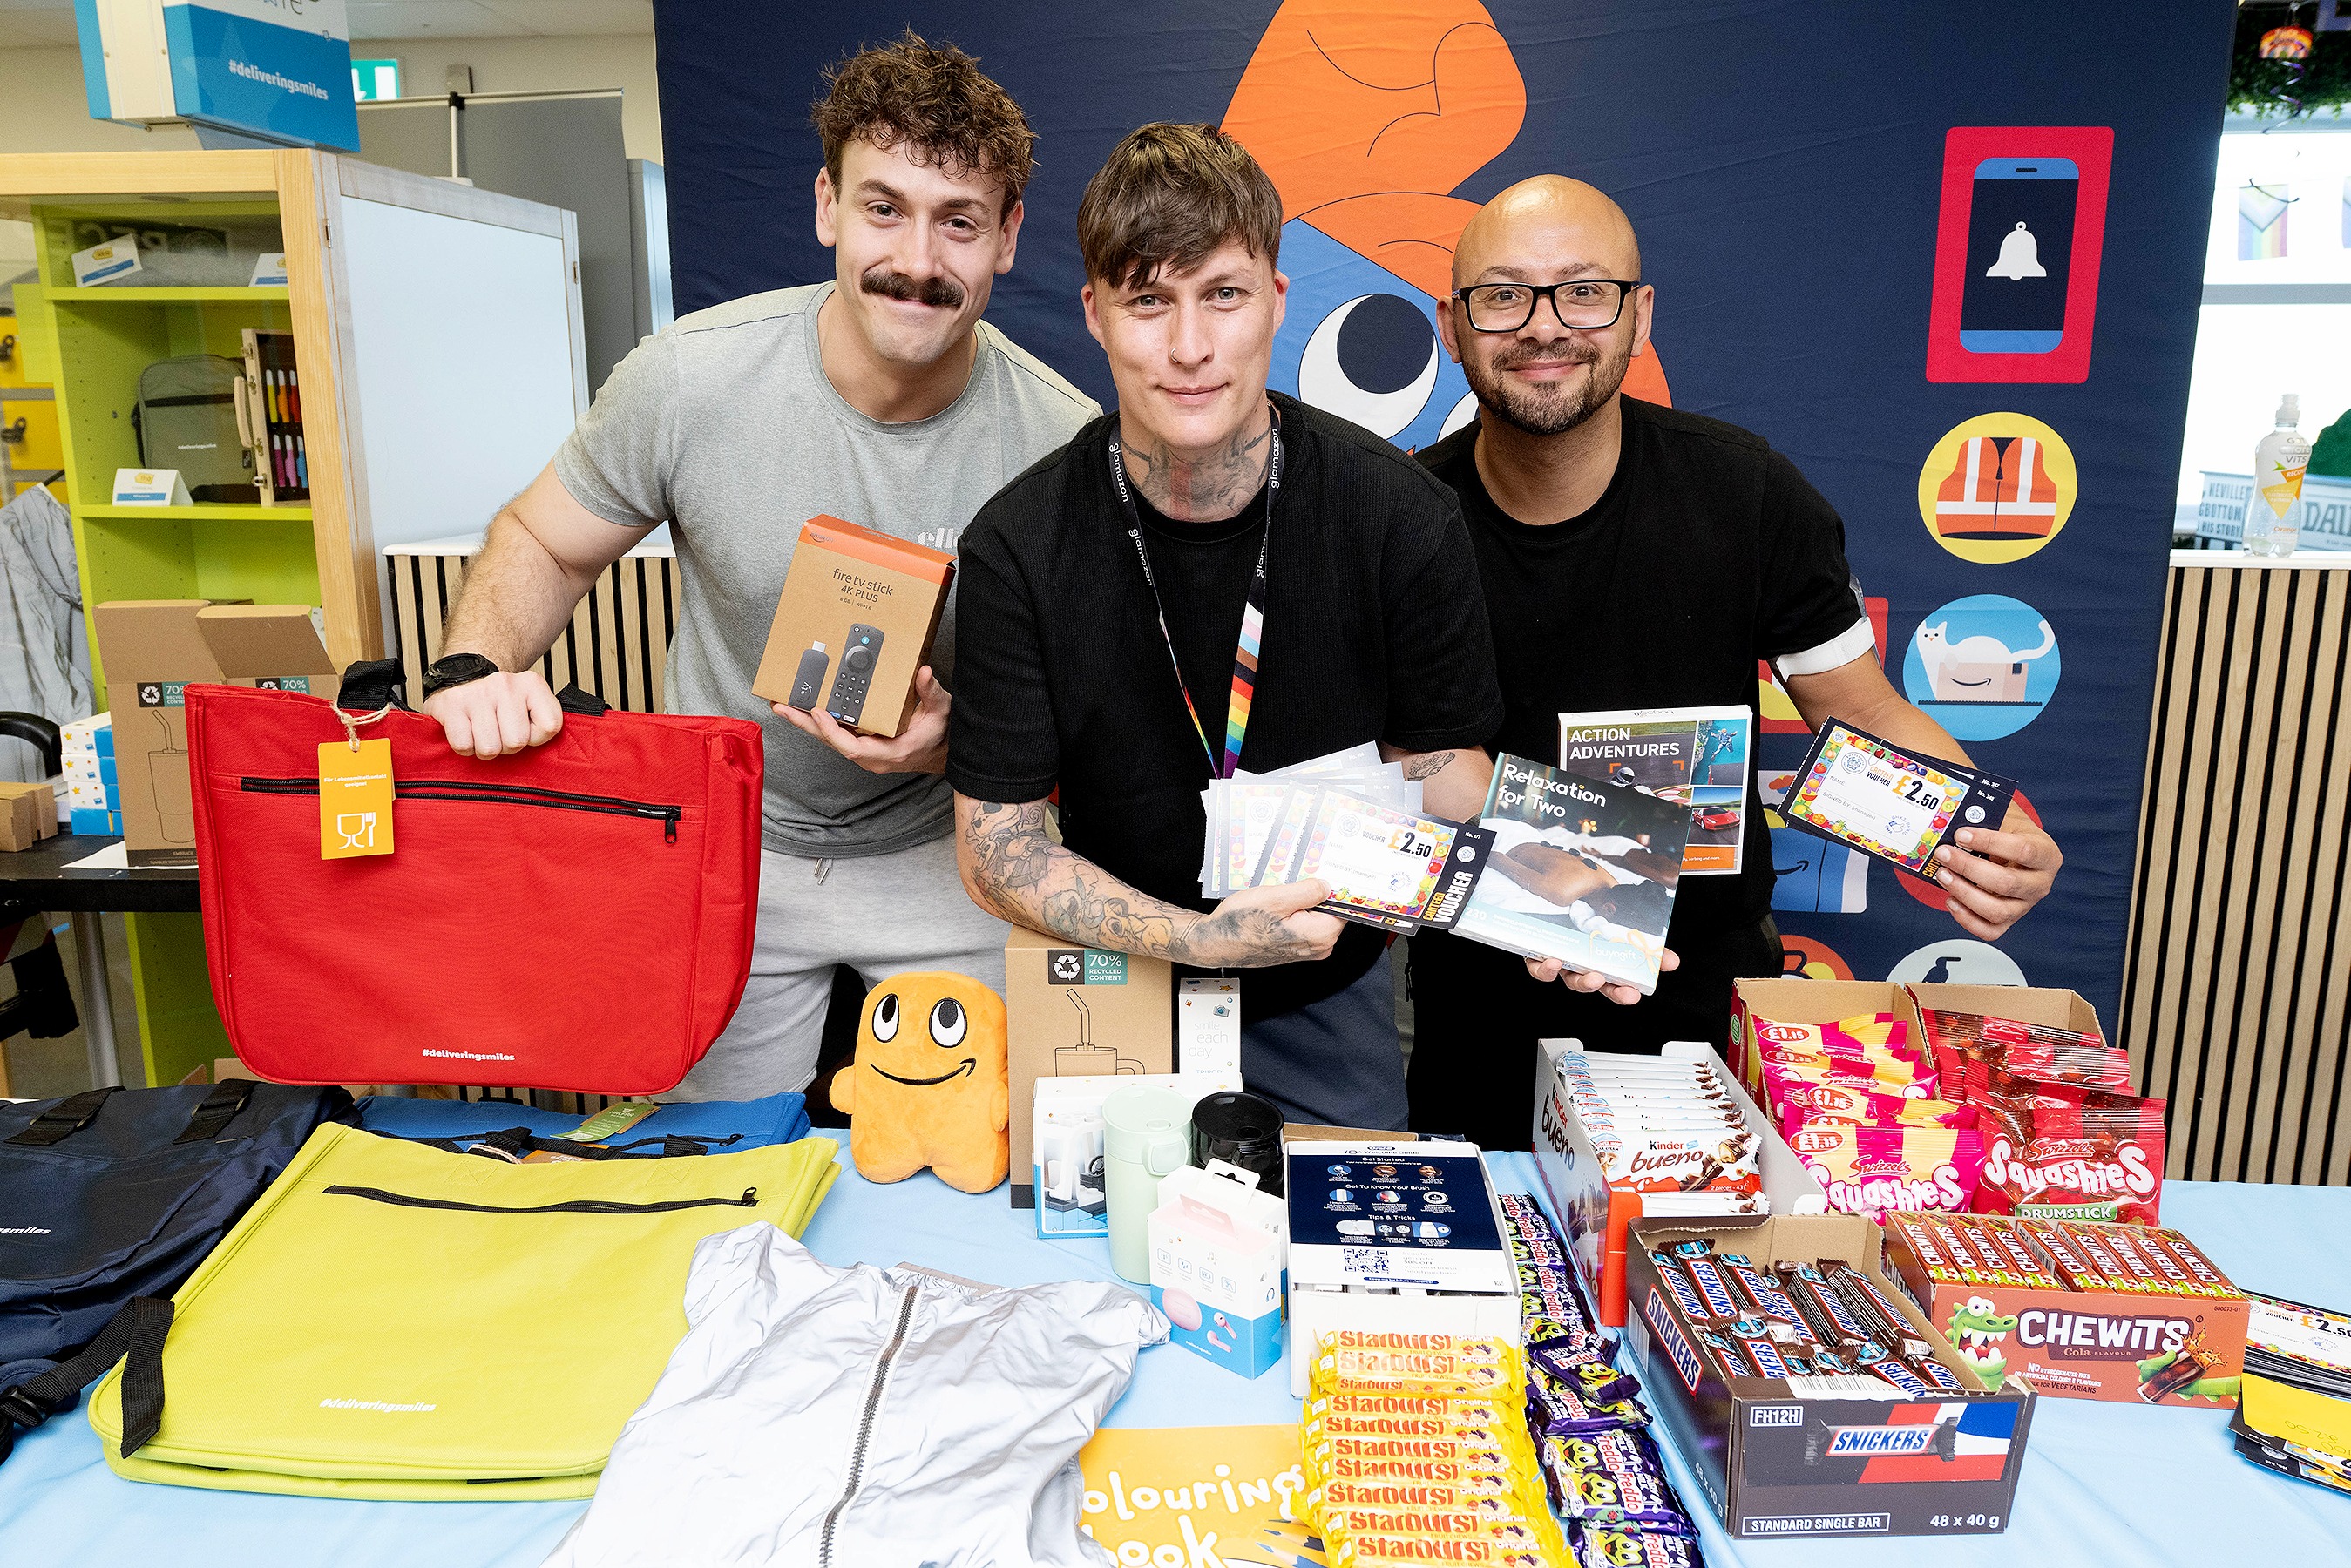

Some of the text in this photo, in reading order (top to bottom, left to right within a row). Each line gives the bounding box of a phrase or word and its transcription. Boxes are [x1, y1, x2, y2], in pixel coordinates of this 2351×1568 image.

[228, 58, 329, 101] #deliveringsmiles
[1271, 429, 1280, 489] glamazon
[1109, 443, 1128, 503] glamazon
[2209, 483, 2246, 500] NEVILLE
[810, 532, 834, 543] amazon
[2216, 524, 2242, 537] STORY
[1128, 528, 1152, 586] glamazon
[833, 568, 852, 584] fire
[866, 580, 893, 596] stick
[841, 585, 879, 603] 4K PLUS
[283, 680, 307, 689] 70%
[1569, 728, 1631, 743] ACTION
[1569, 742, 1680, 760] ADVENTURES
[334, 774, 387, 782] Lebensmittelkontakt
[1867, 771, 1891, 787] VOUCHER
[1869, 766, 1894, 781] CANTEEN
[1502, 762, 1607, 808] Relaxation
[1892, 774, 1940, 811] £2.50
[1498, 785, 1566, 818] for Two
[1823, 792, 1842, 804] SIGNED
[1362, 830, 1386, 843] VOUCHER
[1387, 828, 1432, 858] £2.50
[1922, 856, 1941, 877] CANT
[1422, 892, 1446, 921] CANTEEN
[1432, 870, 1474, 923] VOUCHER
[1089, 954, 1121, 967] 70%
[1595, 946, 1637, 962] buyagift
[1195, 1020, 1220, 1031] smile
[1768, 1028, 1805, 1041] £1.15
[1197, 1031, 1229, 1044] each
[423, 1048, 515, 1061] #deliveringsmiles
[1189, 1044, 1212, 1059] day
[1812, 1088, 1848, 1109] £1.15
[1541, 1093, 1575, 1171] bueno
[1649, 1140, 1684, 1151] Kinder
[1798, 1134, 1838, 1152] £1.15
[2027, 1138, 2095, 1161] Swizzels
[1631, 1150, 1704, 1173] bueno
[1848, 1155, 1912, 1178] Swizzels
[2021, 1206, 2112, 1220] DRUMSTICK
[1903, 1224, 1945, 1266] CHEWITS
[1934, 1226, 1977, 1267] CHEWITS
[1963, 1227, 2008, 1269] CHEWITS
[1995, 1231, 2040, 1273] CHEWITS
[2036, 1232, 2087, 1273] CHEWITS
[2076, 1234, 2123, 1276] CHEWITS
[2106, 1237, 2154, 1278] CHEWITS
[2137, 1239, 2188, 1280] CHEWITS
[2167, 1241, 2220, 1283] CHEWITS
[1665, 1268, 1709, 1318] SNICKERS
[1693, 1263, 1738, 1317] SNICKERS
[1739, 1269, 1785, 1317] SNICKERS
[1815, 1286, 1869, 1340] SNICKERS
[2266, 1311, 2295, 1322] VOUCHER
[1339, 1331, 1451, 1351] Starburst
[1648, 1291, 1699, 1387] SNICKERS
[2019, 1310, 2189, 1352] CHEWITS
[1460, 1355, 1499, 1365] Original
[2063, 1348, 2091, 1356] Cola
[1339, 1351, 1454, 1374] Starburst
[2028, 1362, 2040, 1373] NO
[1339, 1378, 1404, 1391] Starburst
[2022, 1371, 2049, 1382] ARTIFICIAL
[2050, 1375, 2072, 1384] COLOURS
[2077, 1378, 2102, 1387] FLAVOURS
[2050, 1382, 2097, 1394] VEGETARIANS
[319, 1398, 437, 1413] #deliveringsmiles
[1332, 1396, 1449, 1415] Starburst
[1453, 1398, 1493, 1407] Original
[1325, 1416, 1445, 1436] Starburst
[1755, 1409, 1799, 1423] FH12H
[1336, 1438, 1456, 1458] Starburst
[1460, 1441, 1502, 1450] Original
[1834, 1429, 1929, 1451] SNICKERS
[1598, 1436, 1620, 1471] Freddo
[1336, 1458, 1459, 1480] Starburst
[1464, 1464, 1506, 1473] Original
[1083, 1463, 1305, 1521] olouring
[1328, 1484, 1453, 1505] Starburst
[1459, 1488, 1502, 1497] Original
[1617, 1472, 1639, 1511] Freddo
[1351, 1511, 1478, 1533] Starburst
[1483, 1514, 1527, 1523] Original
[1751, 1517, 1880, 1531] STANDARD SINGLE BAR
[1930, 1514, 2000, 1529] 48 x 40 g
[1358, 1537, 1490, 1561] Starburst
[1495, 1540, 1540, 1551] Original
